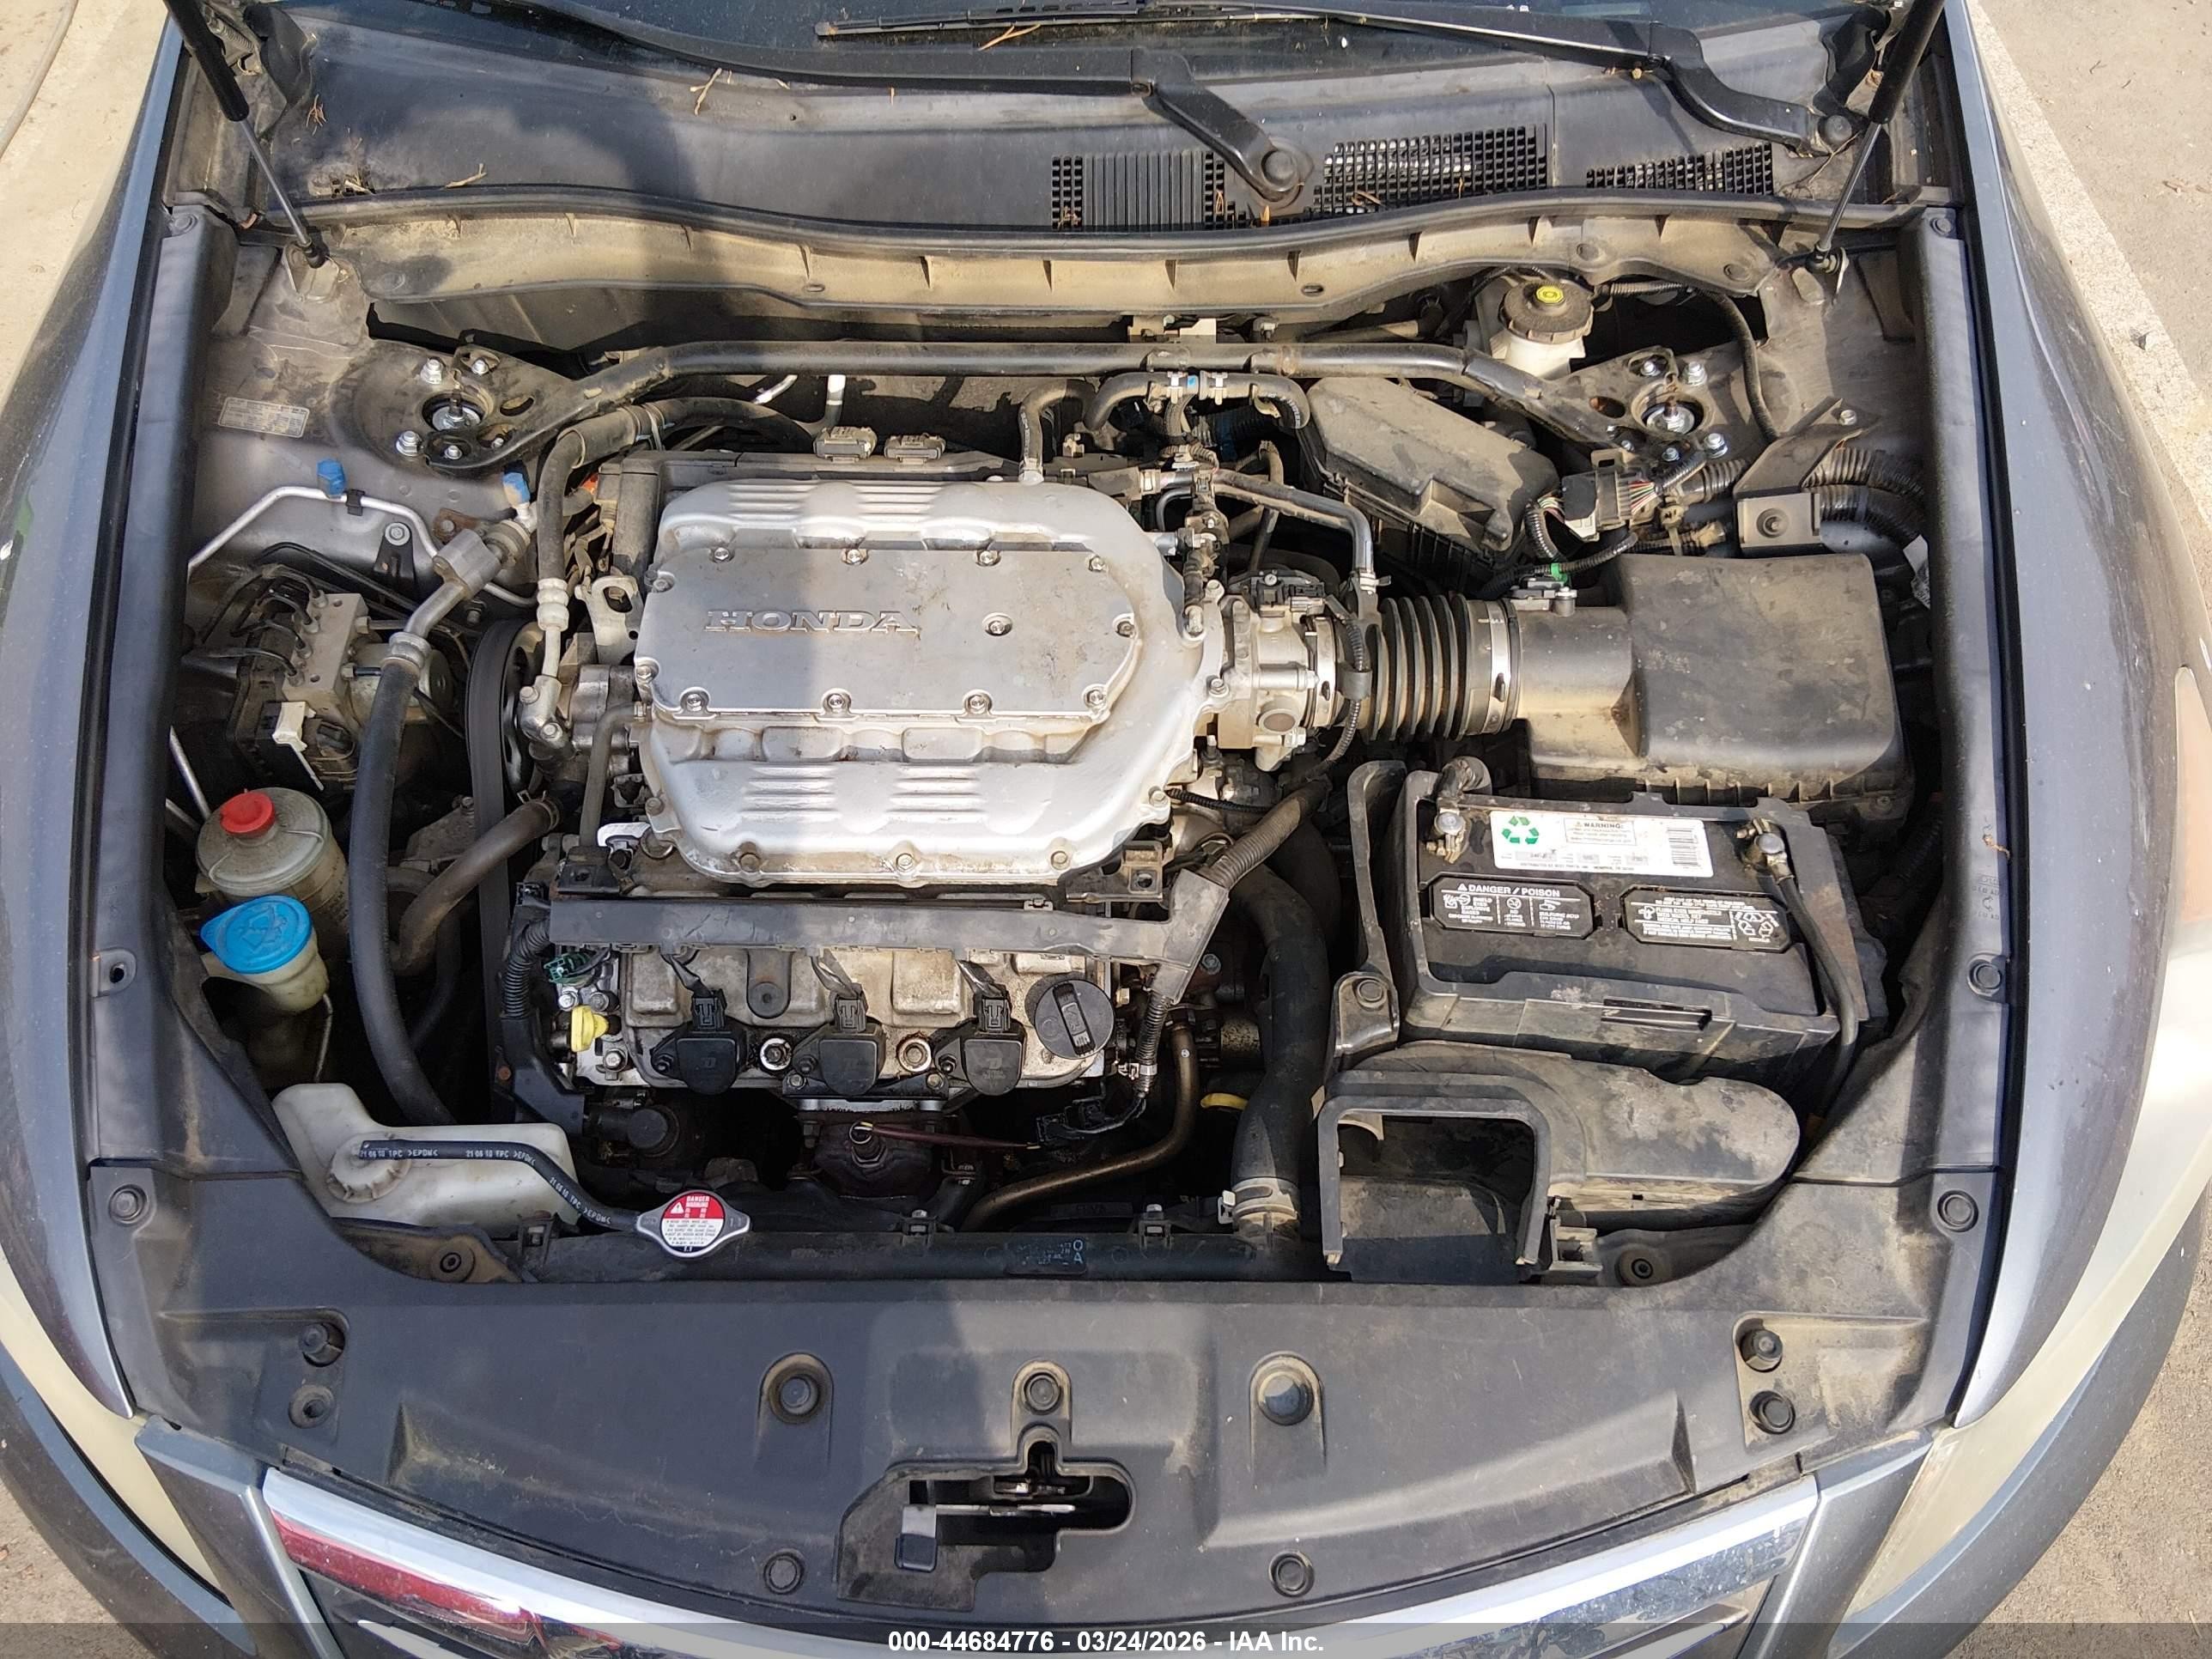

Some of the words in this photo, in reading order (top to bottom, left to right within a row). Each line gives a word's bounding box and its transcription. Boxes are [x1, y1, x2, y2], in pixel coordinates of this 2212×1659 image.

[703, 611, 919, 633] HONDA
[1468, 884, 1511, 894] DANGER
[1521, 888, 1560, 897] POISON
